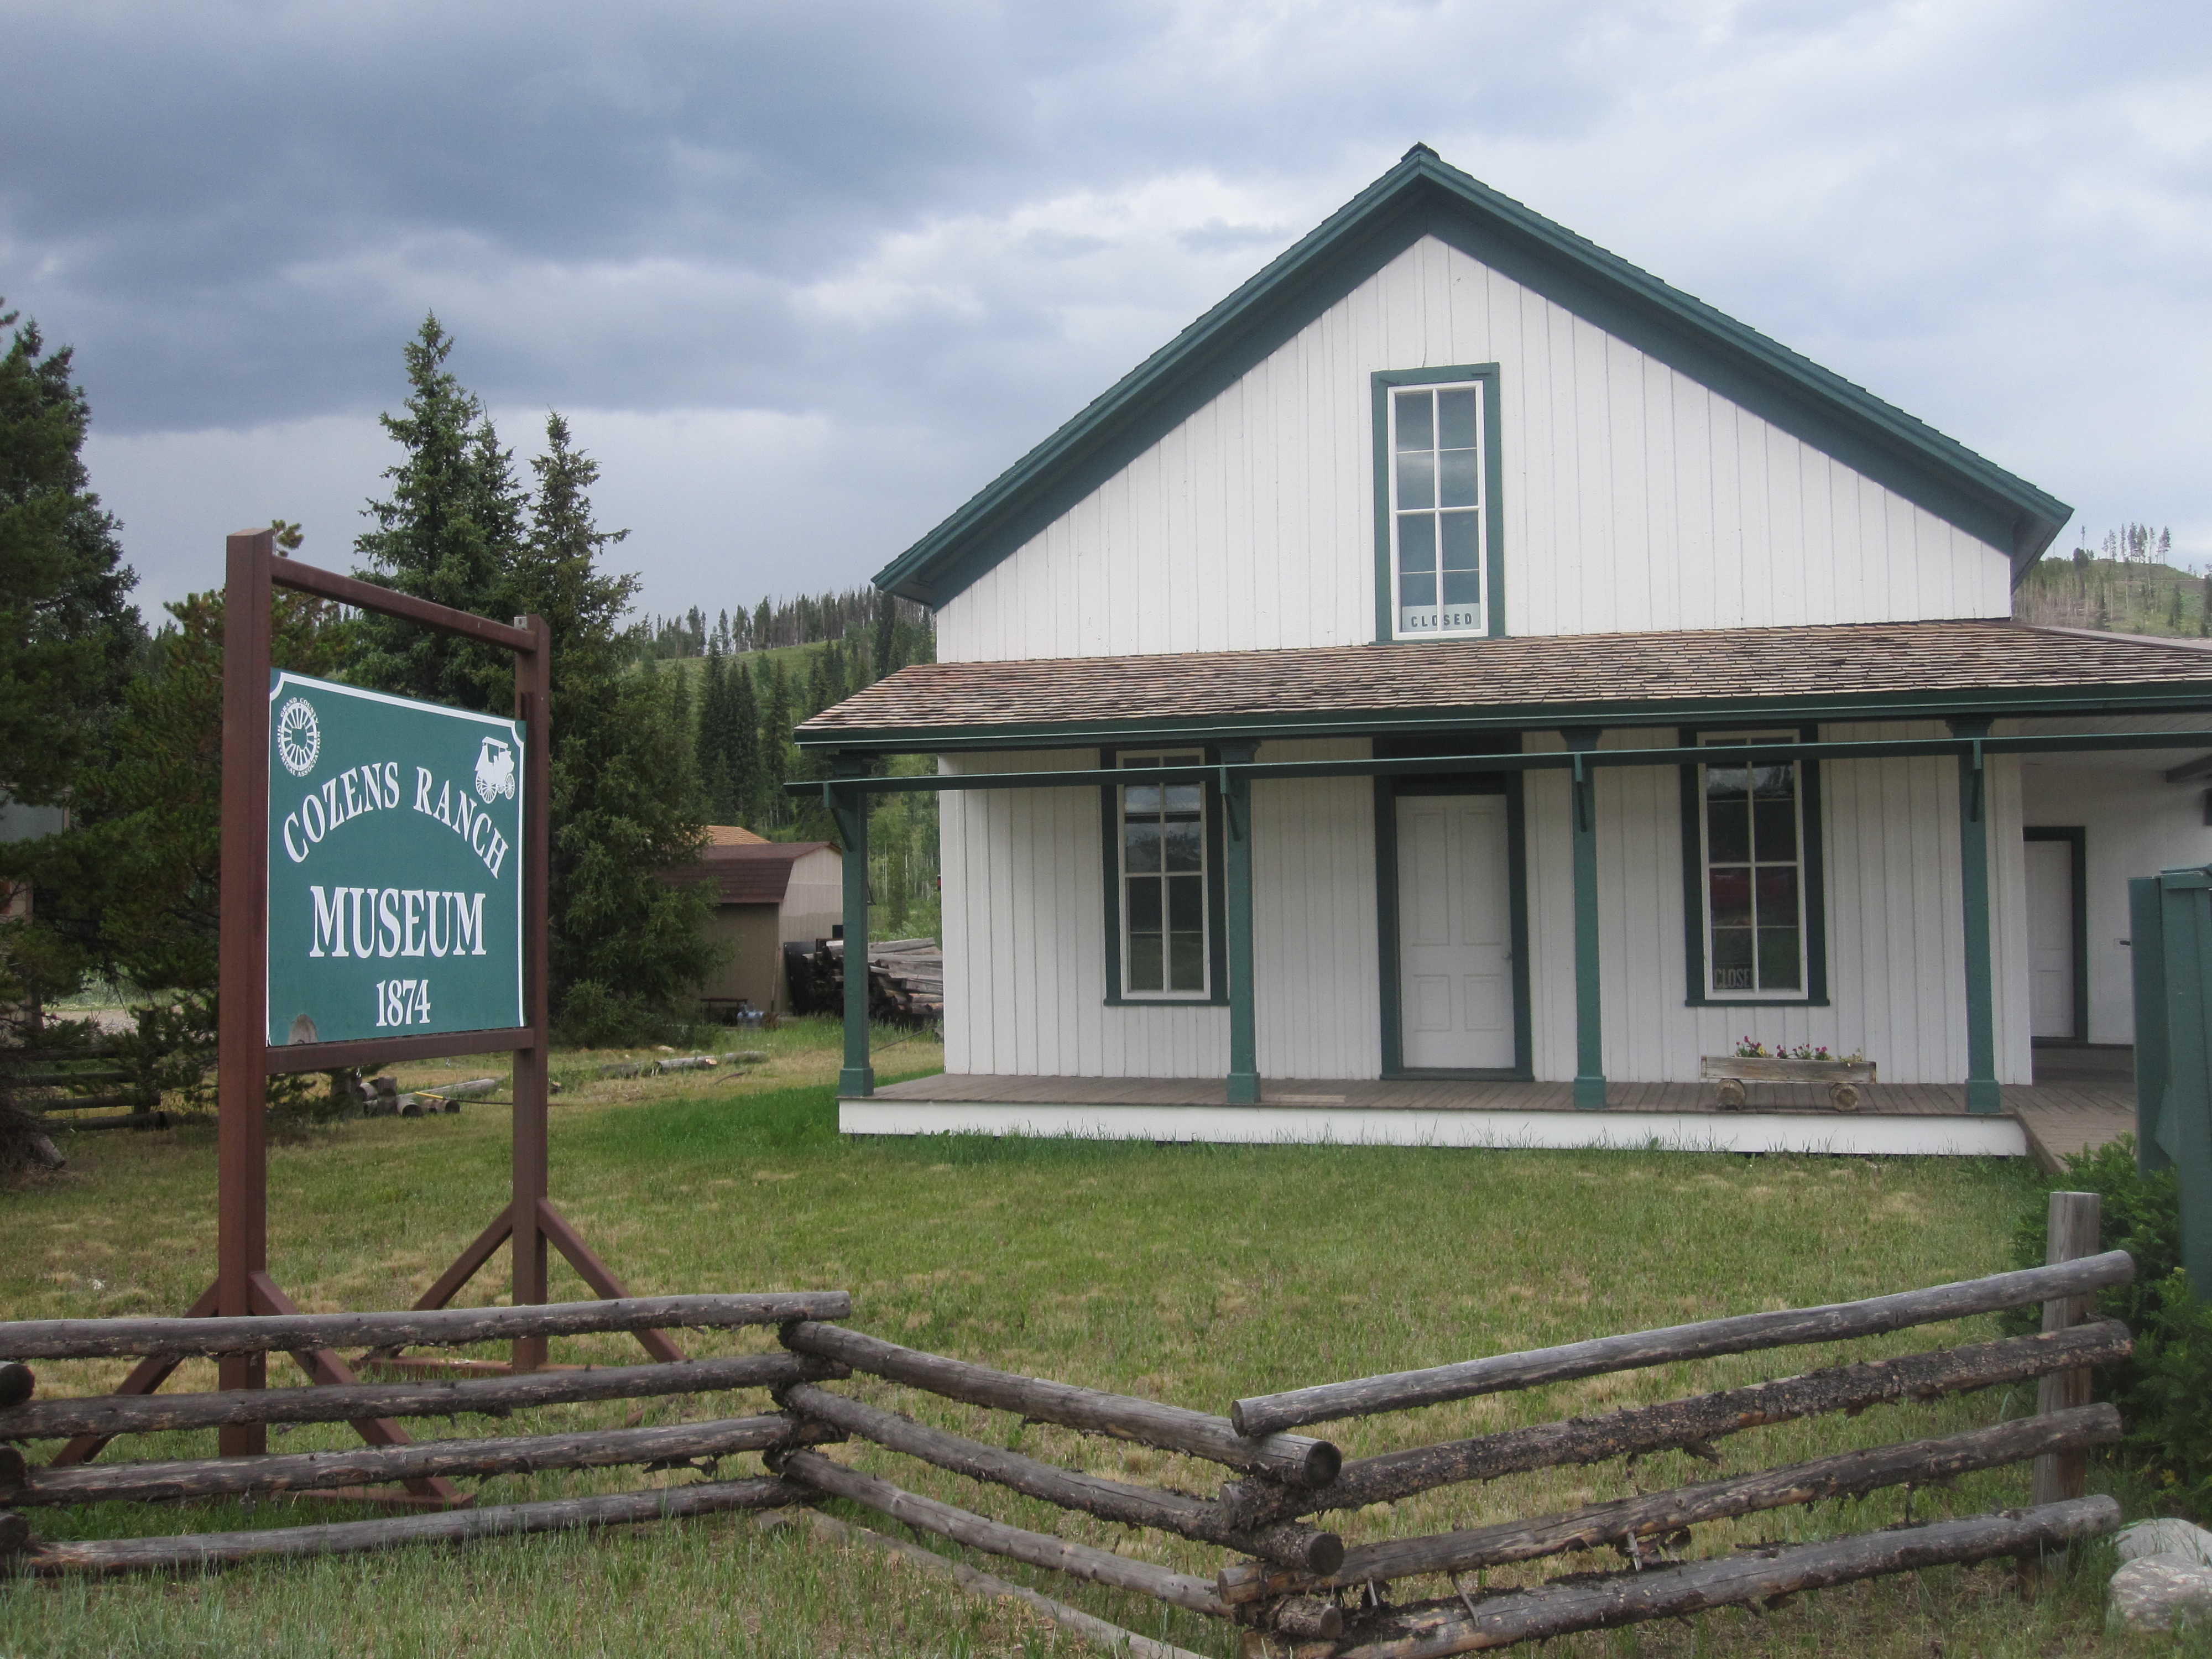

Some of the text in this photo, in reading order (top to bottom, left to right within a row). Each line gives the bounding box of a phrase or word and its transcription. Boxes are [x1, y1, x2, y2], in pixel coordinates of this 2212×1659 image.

[1411, 613, 1472, 627] CLOSED
[280, 697, 319, 723] GRAND COUNTY
[277, 725, 320, 777] HISTORICAL ASSOCIATION
[284, 761, 508, 879] COZENS RANCH
[309, 885, 486, 958] MUSEUM
[1714, 967, 1752, 988] CLOSE
[376, 979, 431, 1027] 1874
